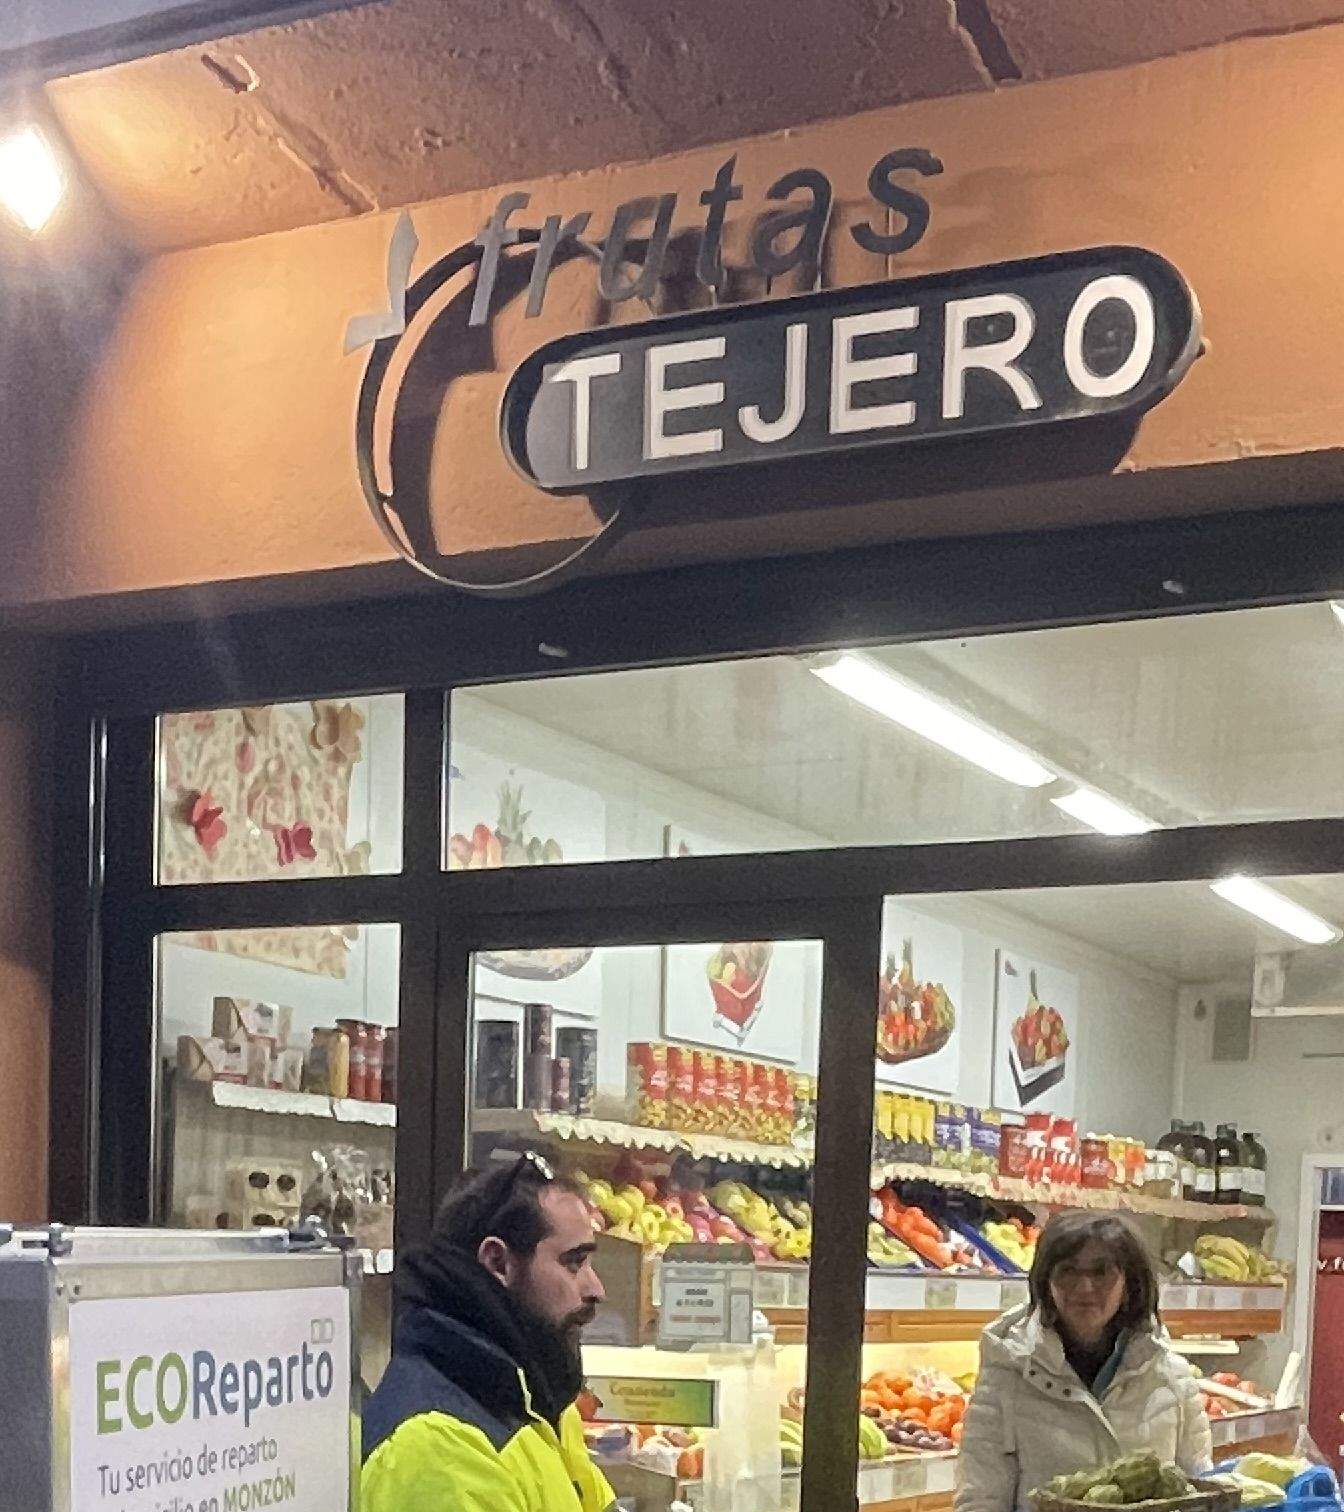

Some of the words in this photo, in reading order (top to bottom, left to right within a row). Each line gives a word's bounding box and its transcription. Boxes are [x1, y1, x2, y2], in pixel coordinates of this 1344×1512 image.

[467, 148, 946, 327] frutas
[542, 274, 1155, 471] TEJERO
[96, 1341, 333, 1436] ECOReparto
[98, 1464, 120, 1497] Tu
[125, 1447, 193, 1491] servicio
[197, 1443, 218, 1477] de
[221, 1436, 278, 1474] reparto
